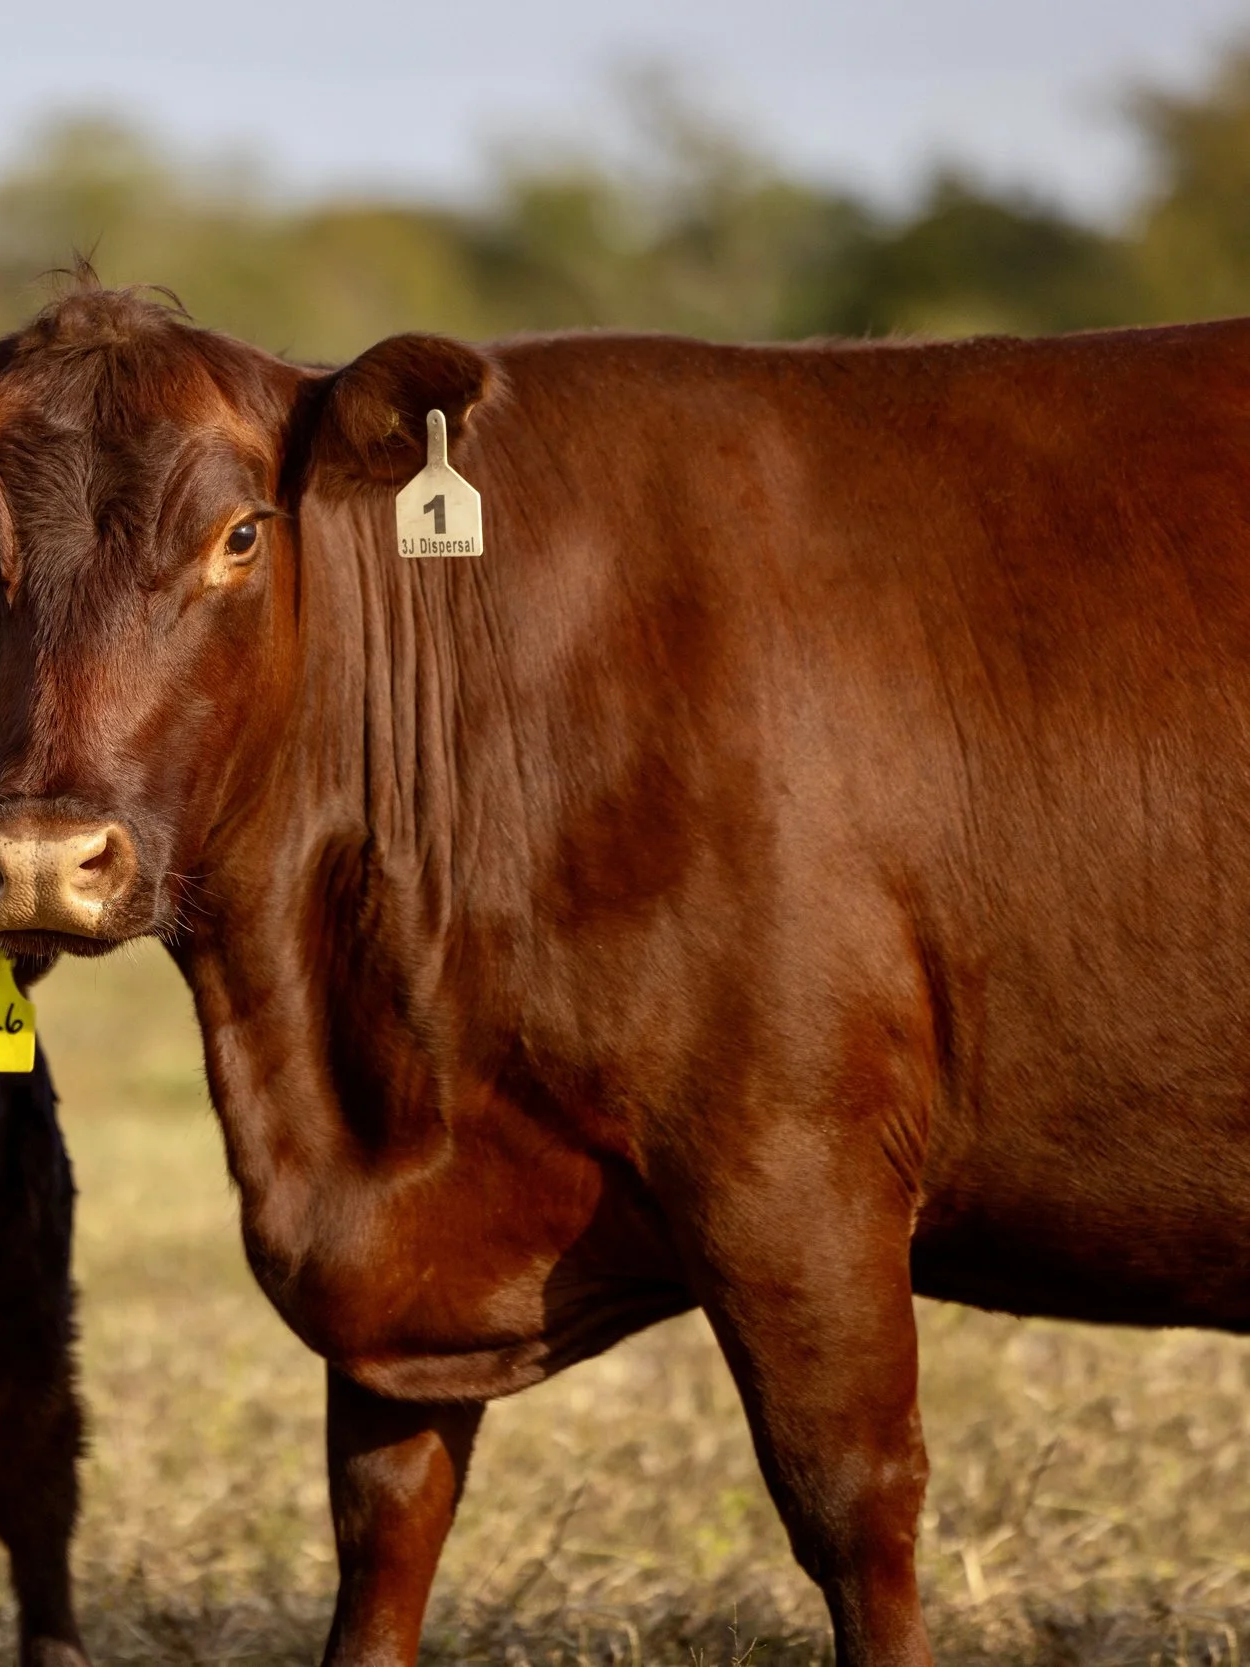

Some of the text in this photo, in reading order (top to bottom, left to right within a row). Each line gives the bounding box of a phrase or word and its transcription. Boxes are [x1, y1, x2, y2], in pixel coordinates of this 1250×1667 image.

[423, 494, 447, 534] 1
[401, 537, 475, 557] 3J Dispersal
